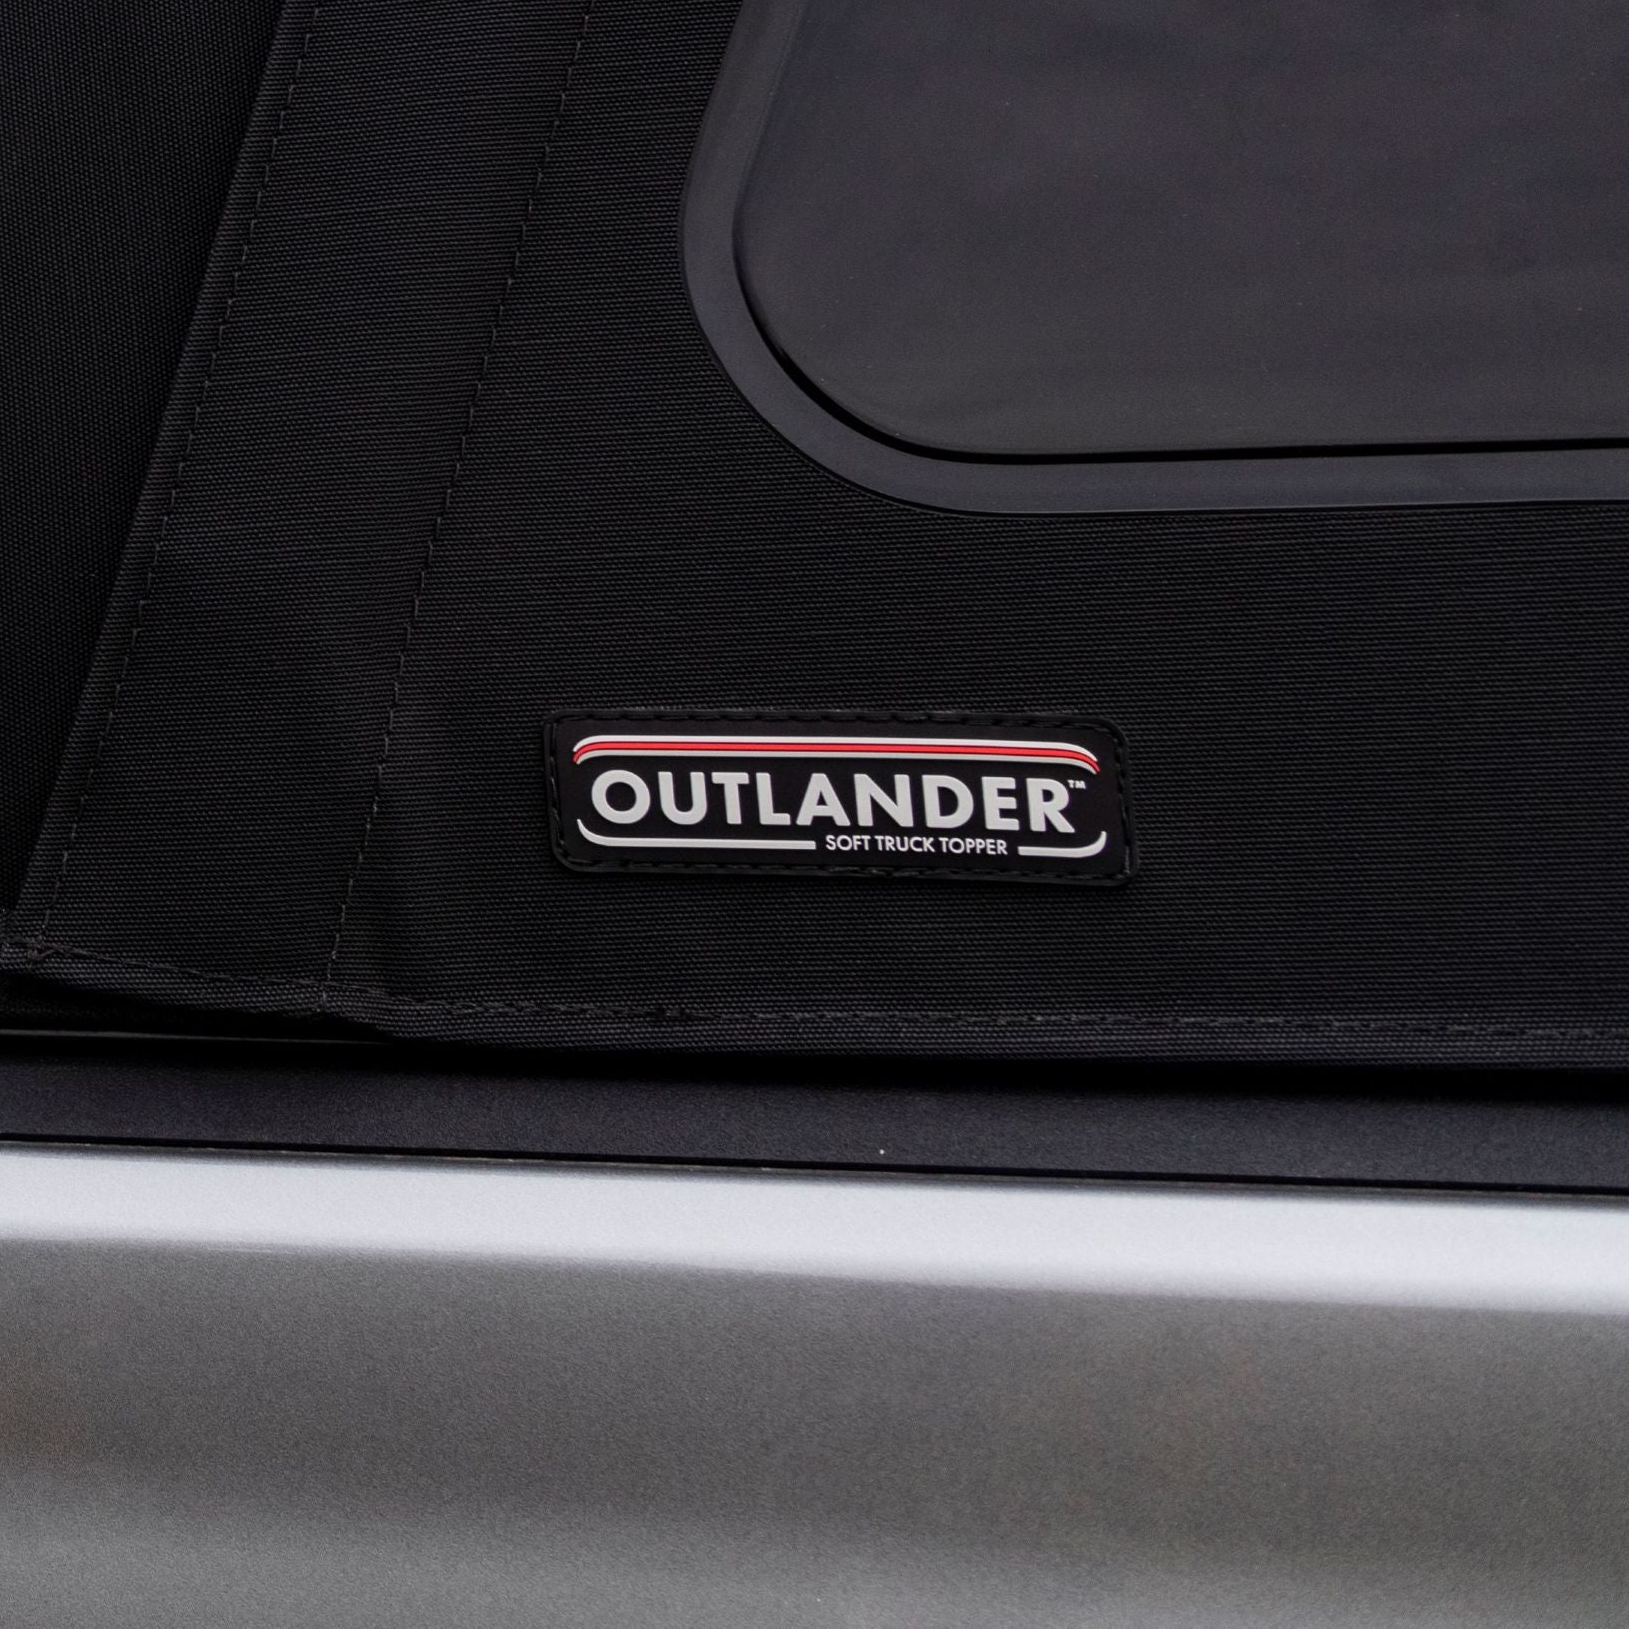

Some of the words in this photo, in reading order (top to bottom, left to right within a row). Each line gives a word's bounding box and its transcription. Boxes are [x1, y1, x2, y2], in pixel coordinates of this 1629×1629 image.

[825, 834, 872, 851] SOFT
[873, 834, 936, 853] TRUCK
[938, 836, 1008, 855] TOPPER
